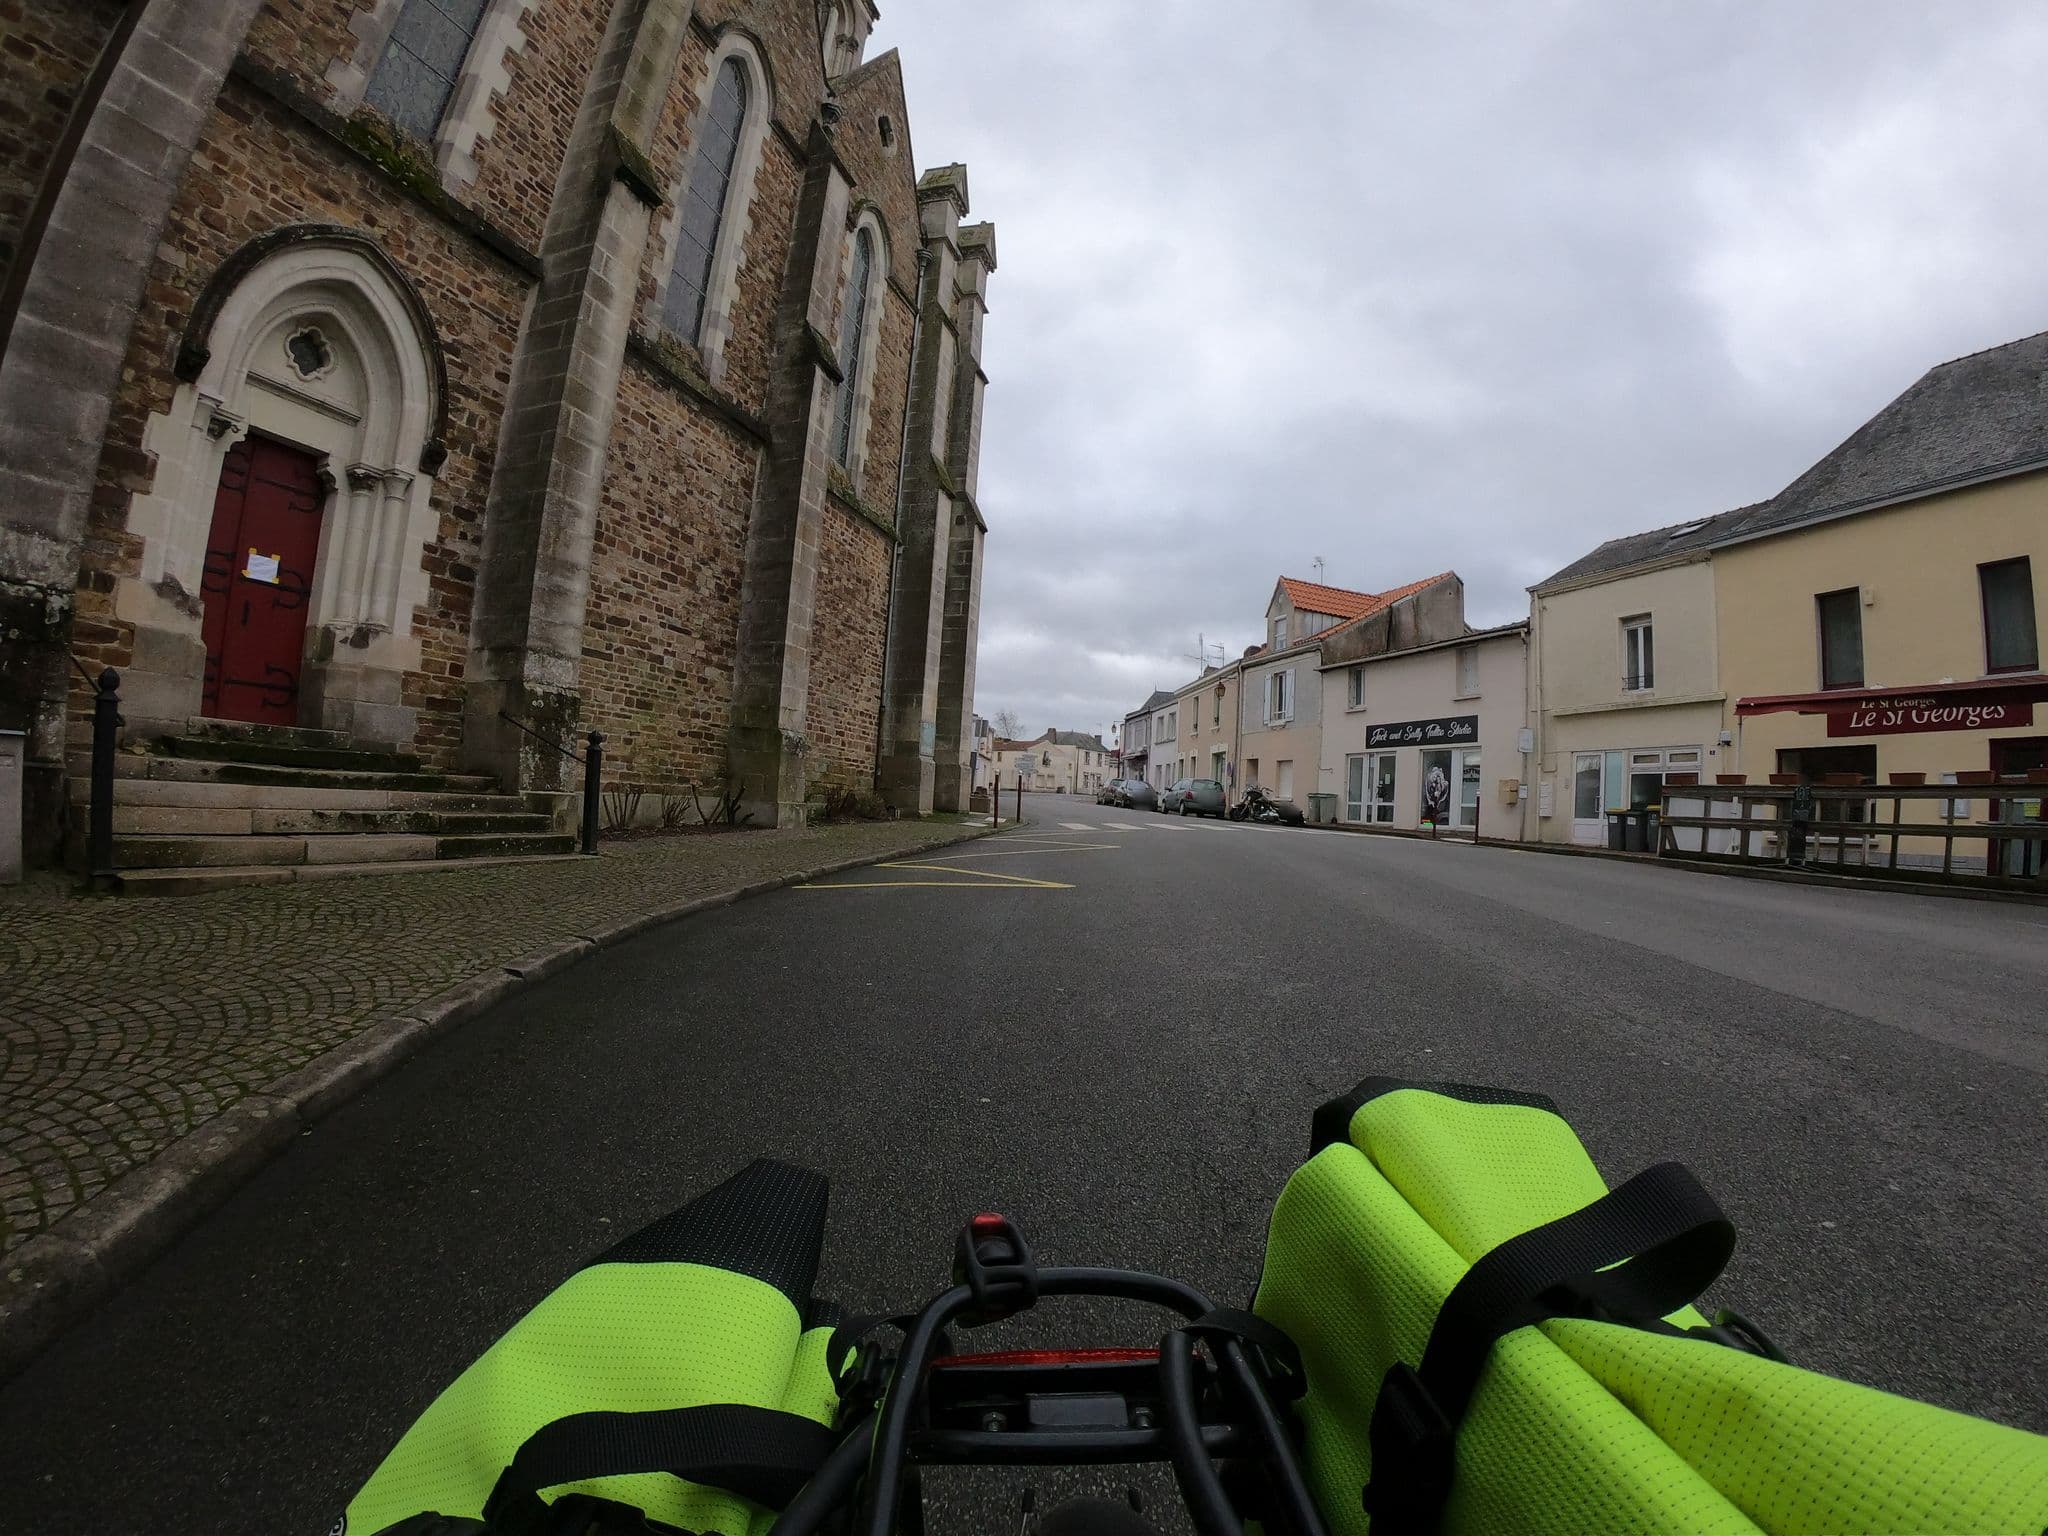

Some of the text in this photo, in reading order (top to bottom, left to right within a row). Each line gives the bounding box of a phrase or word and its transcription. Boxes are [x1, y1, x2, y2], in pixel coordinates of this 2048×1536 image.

[1861, 700, 1875, 709] Le
[1894, 697, 1937, 708] Georges
[1850, 711, 1877, 728] Le
[1911, 705, 2006, 727] Georges
[1389, 729, 1403, 740] and
